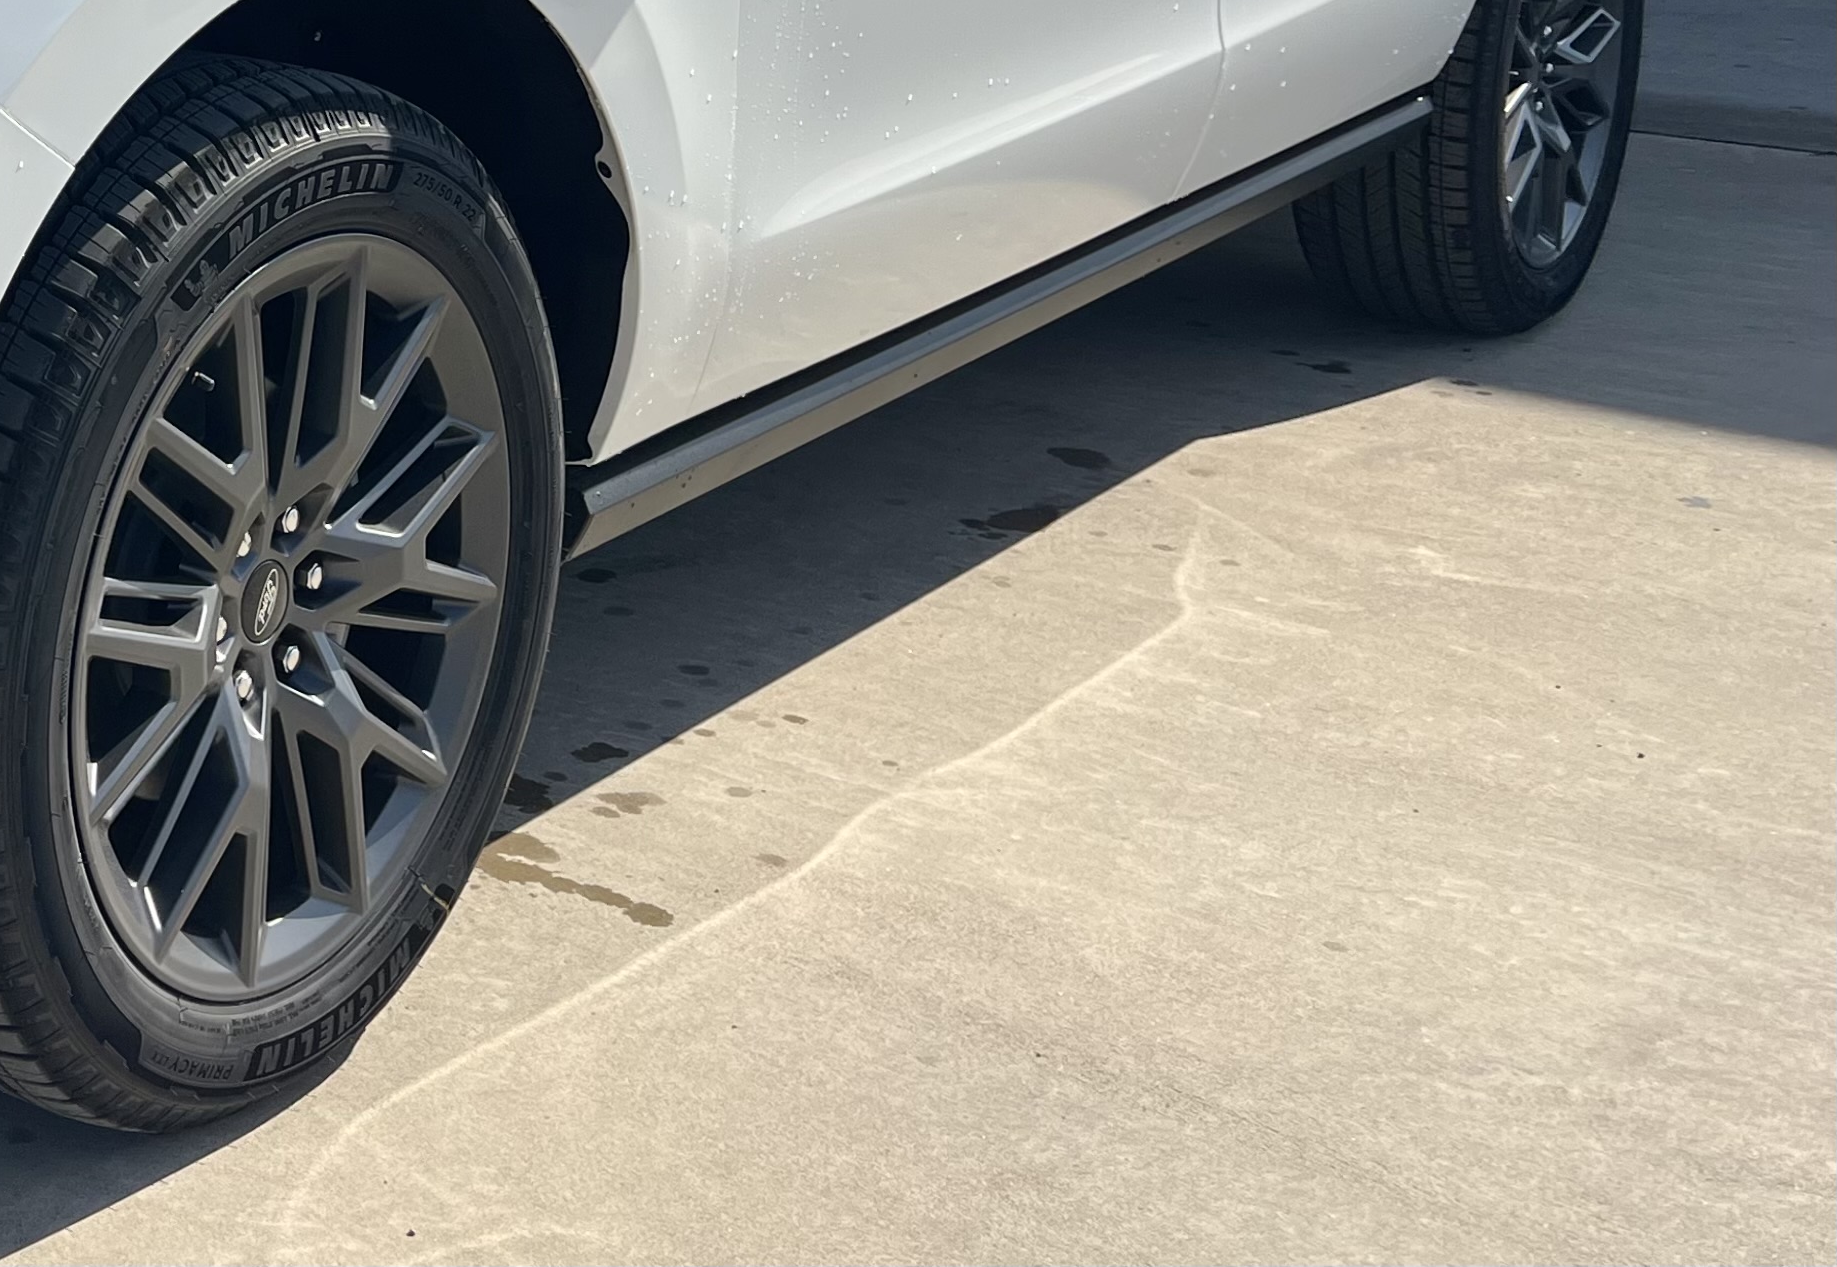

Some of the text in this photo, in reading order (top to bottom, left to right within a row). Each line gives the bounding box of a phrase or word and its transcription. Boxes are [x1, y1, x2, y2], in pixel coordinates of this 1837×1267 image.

[228, 163, 394, 259] MICHELIN
[412, 172, 477, 221] 275/50 R 22
[258, 934, 412, 1078] MICHELIN
[170, 1056, 235, 1081] PRIMACY
